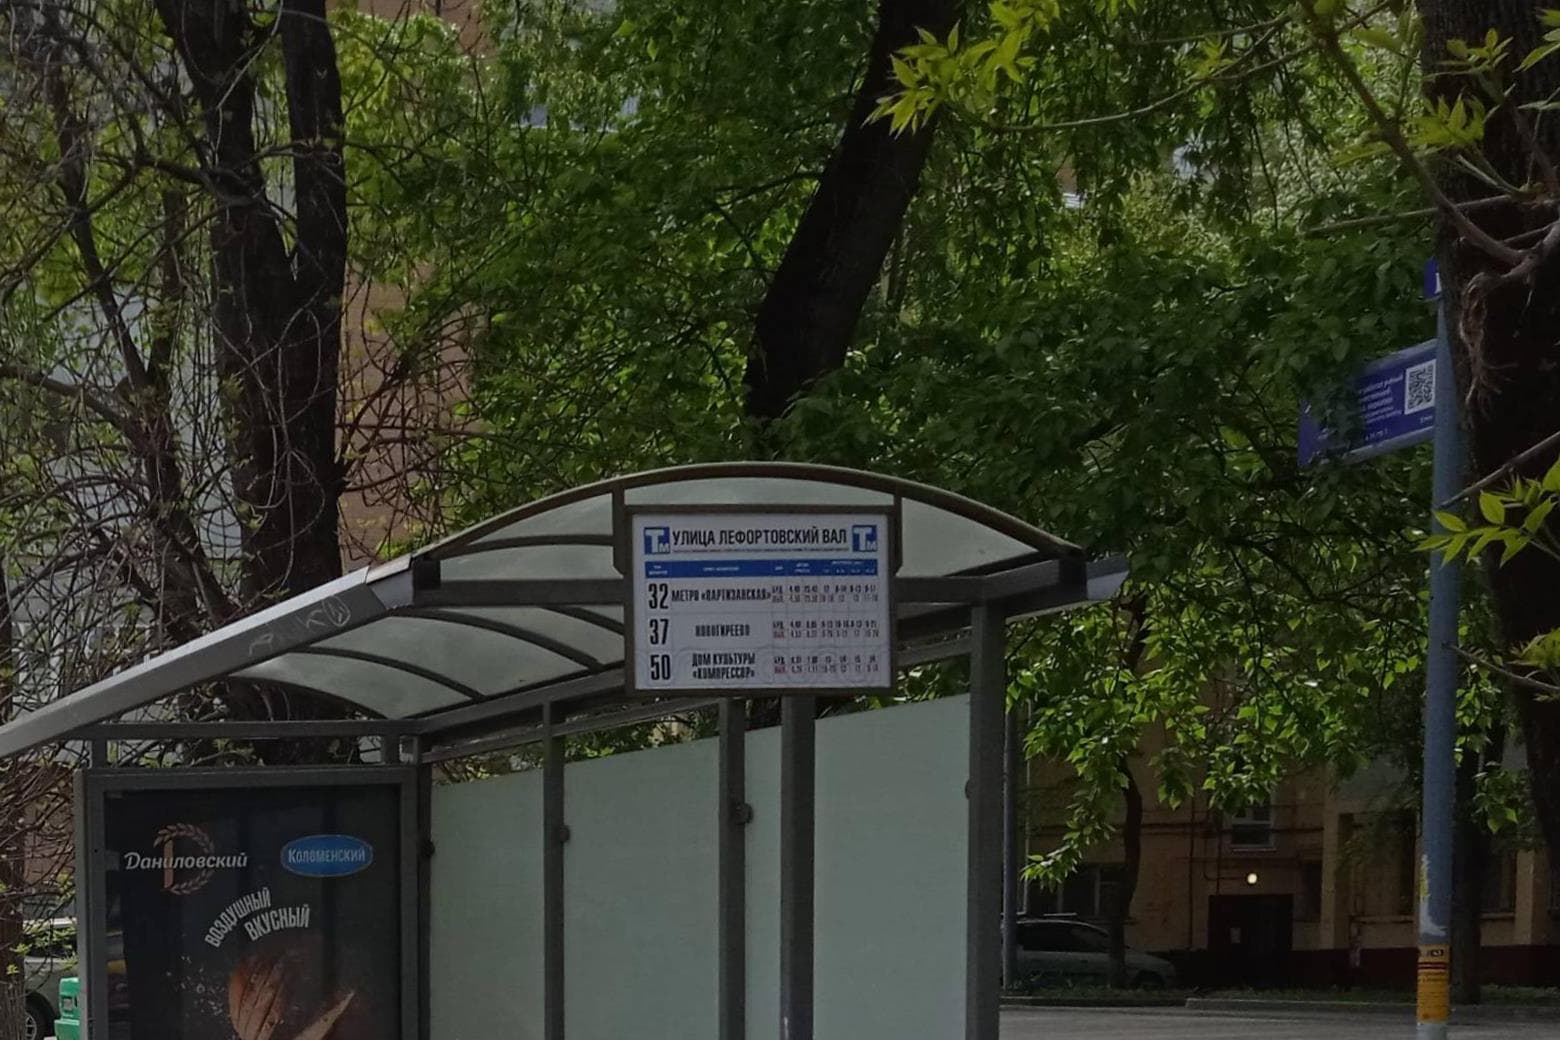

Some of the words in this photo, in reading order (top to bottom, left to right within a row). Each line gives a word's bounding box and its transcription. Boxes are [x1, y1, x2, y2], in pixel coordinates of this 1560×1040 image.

[672, 530, 715, 547] УЛИЦА
[718, 526, 819, 545] ЛЕФОРТОВСКИЙ
[822, 529, 848, 544] ВАЛ
[648, 583, 669, 610] 32
[671, 589, 700, 602] МЕТРО
[649, 618, 670, 645] 37
[649, 654, 671, 681] 50
[692, 653, 711, 667] ДОМ
[712, 652, 756, 666] КУЛЬТУРЫ
[123, 850, 249, 871] Даниловский
[204, 886, 272, 948] ВОЗДУШНЫЙ
[244, 903, 311, 942] ВКУСНЫЙ
